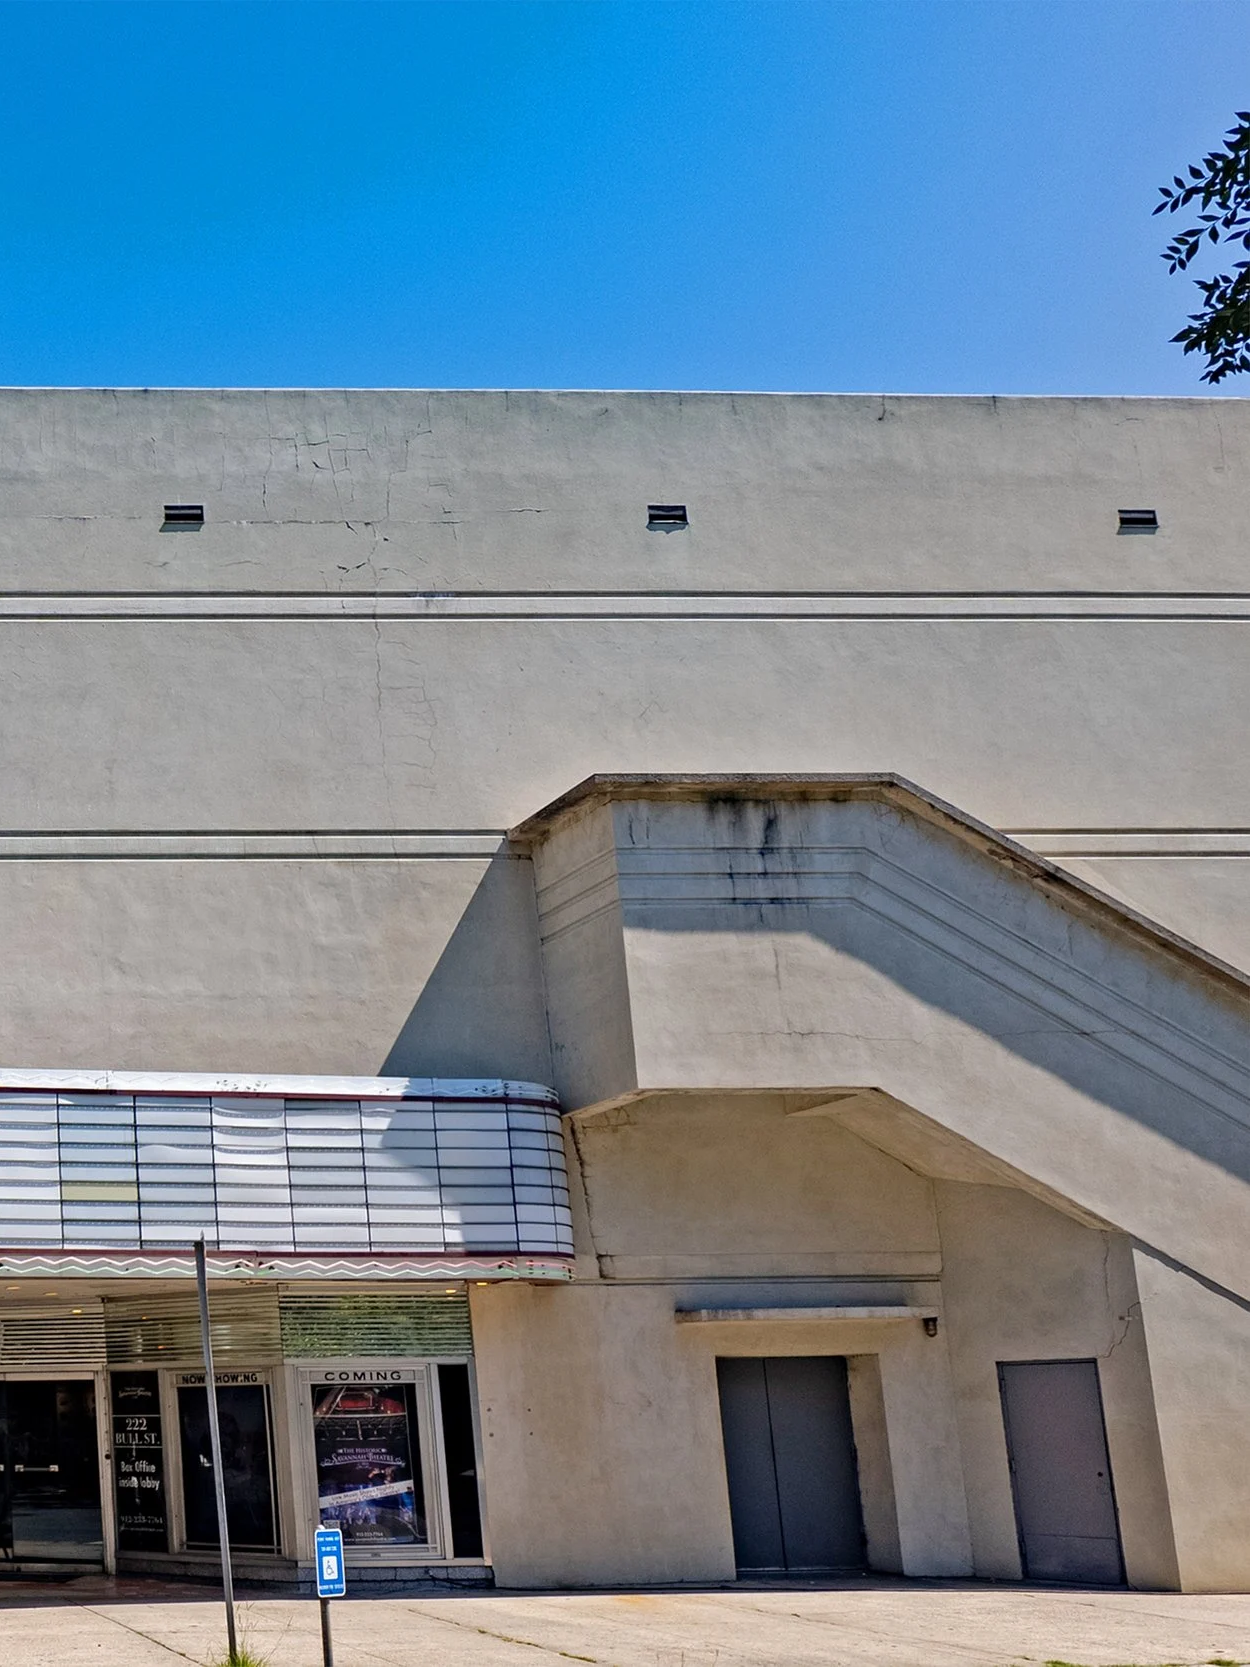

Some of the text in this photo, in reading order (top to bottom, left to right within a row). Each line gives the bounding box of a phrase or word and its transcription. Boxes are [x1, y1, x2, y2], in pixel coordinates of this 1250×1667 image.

[182, 1375, 206, 1385] NOW
[324, 1370, 402, 1381] COMING
[125, 1417, 148, 1431] 222
[115, 1432, 160, 1445] BULL ST.
[121, 1460, 156, 1473] Box Office
[118, 1475, 160, 1491] inside lobby
